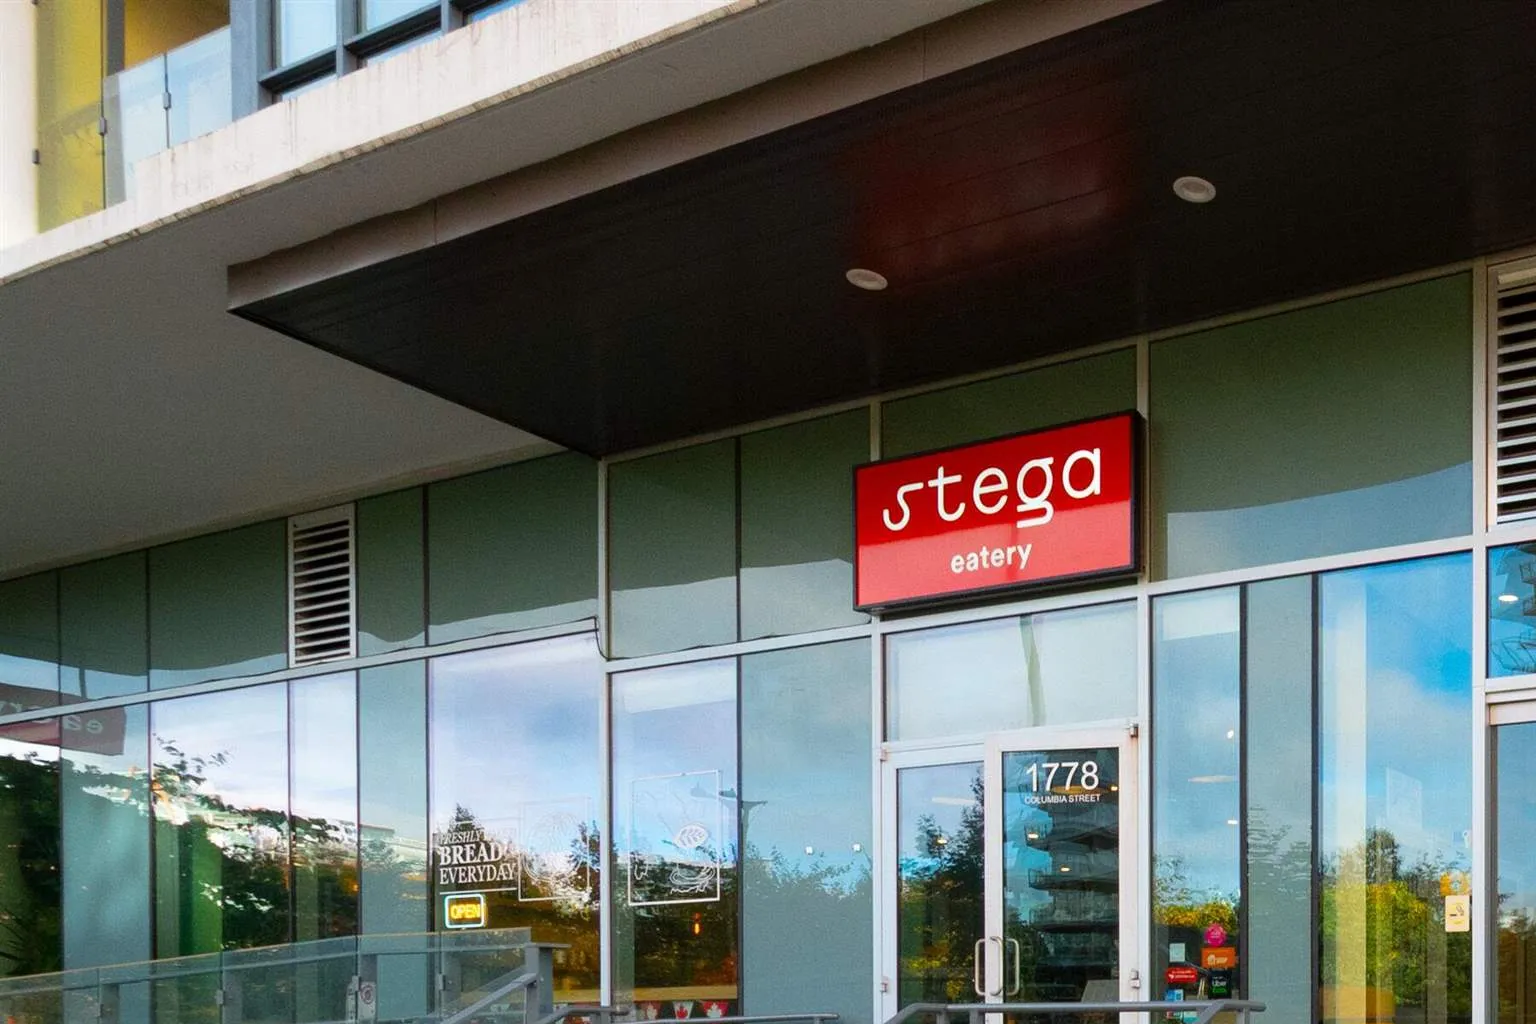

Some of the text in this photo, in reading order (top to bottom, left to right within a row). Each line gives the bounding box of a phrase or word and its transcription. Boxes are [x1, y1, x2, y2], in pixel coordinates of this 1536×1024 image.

[882, 448, 1101, 531] stega
[950, 543, 1032, 574] eatery
[1026, 761, 1099, 792] 1778
[1024, 794, 1101, 804] COLUMBIA STREET
[439, 842, 502, 866] BREAD
[440, 863, 516, 884] EVERYDAY
[450, 903, 482, 920] OPEN
